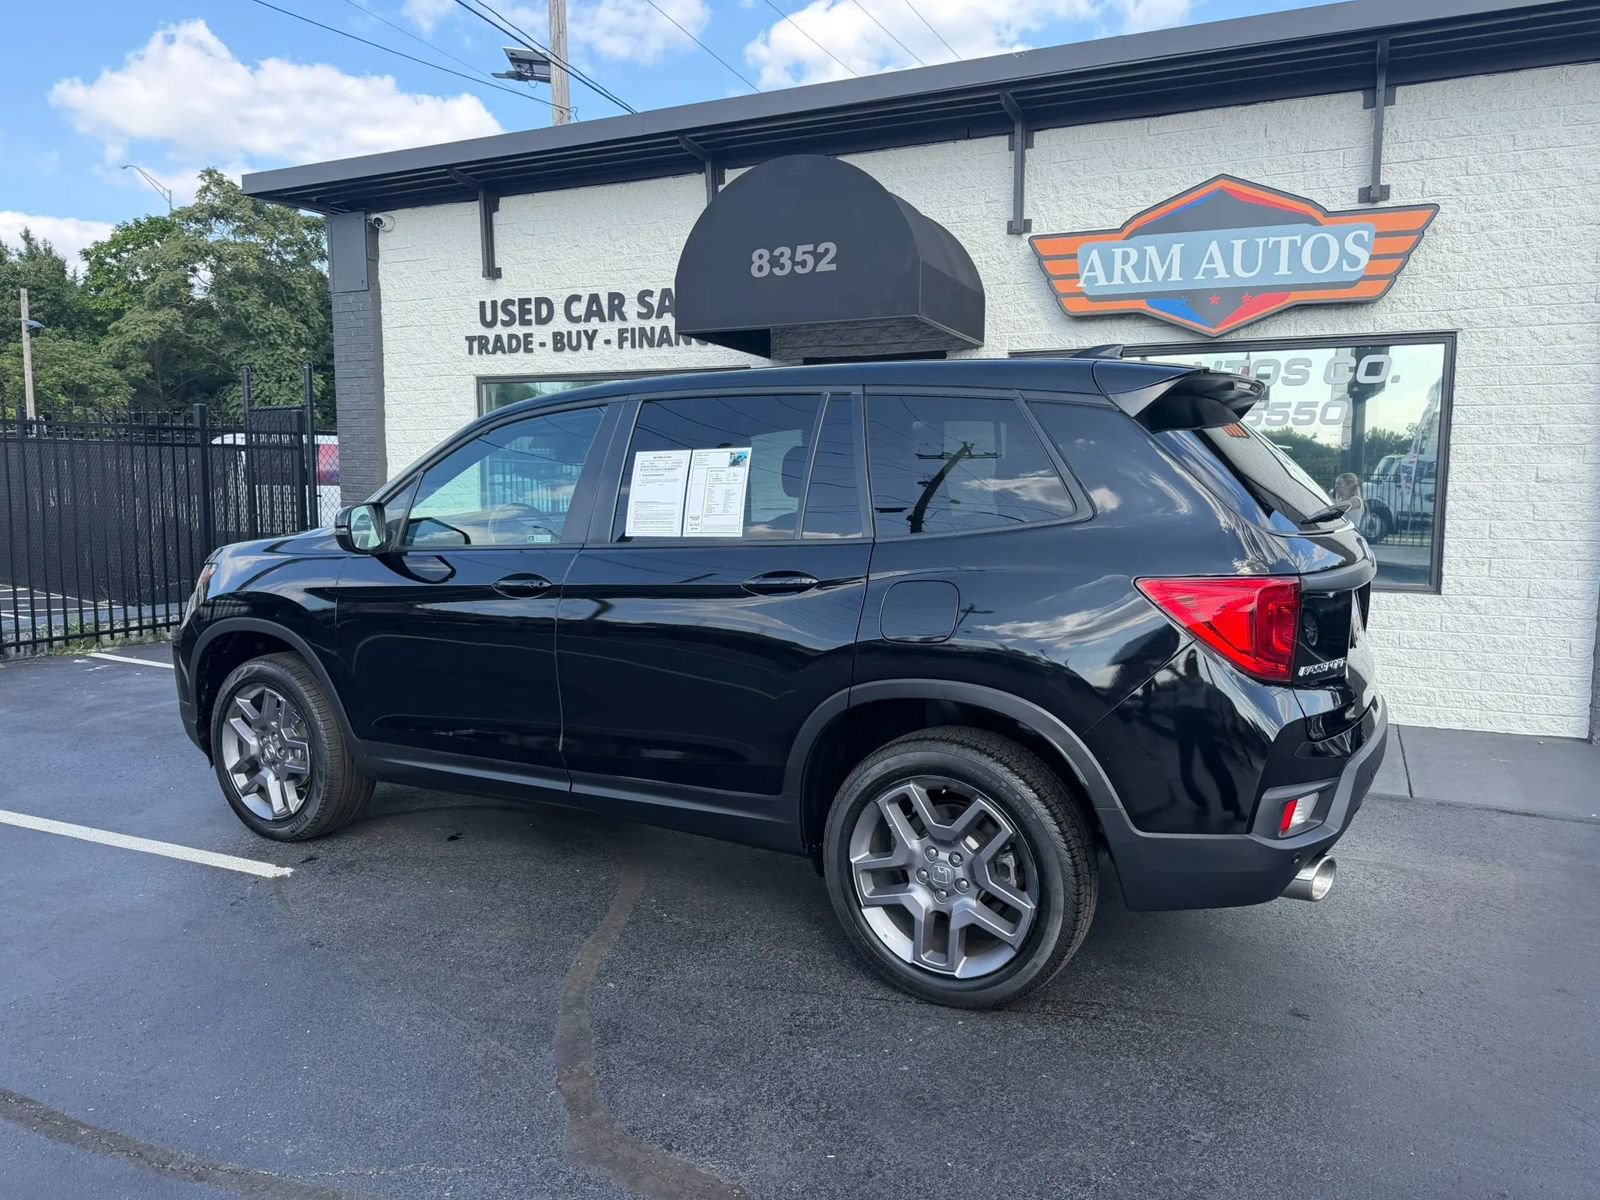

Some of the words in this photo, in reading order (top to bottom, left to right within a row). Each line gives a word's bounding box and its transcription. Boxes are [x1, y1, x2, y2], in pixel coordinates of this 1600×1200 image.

[750, 241, 838, 278] 8352
[1076, 244, 1184, 287] ARM
[1195, 230, 1371, 279] AUTOS
[479, 297, 555, 328] USED
[564, 291, 627, 323] CAR
[465, 333, 534, 355] TRADE
[552, 329, 599, 352] BUY
[617, 326, 712, 349] FINAN
